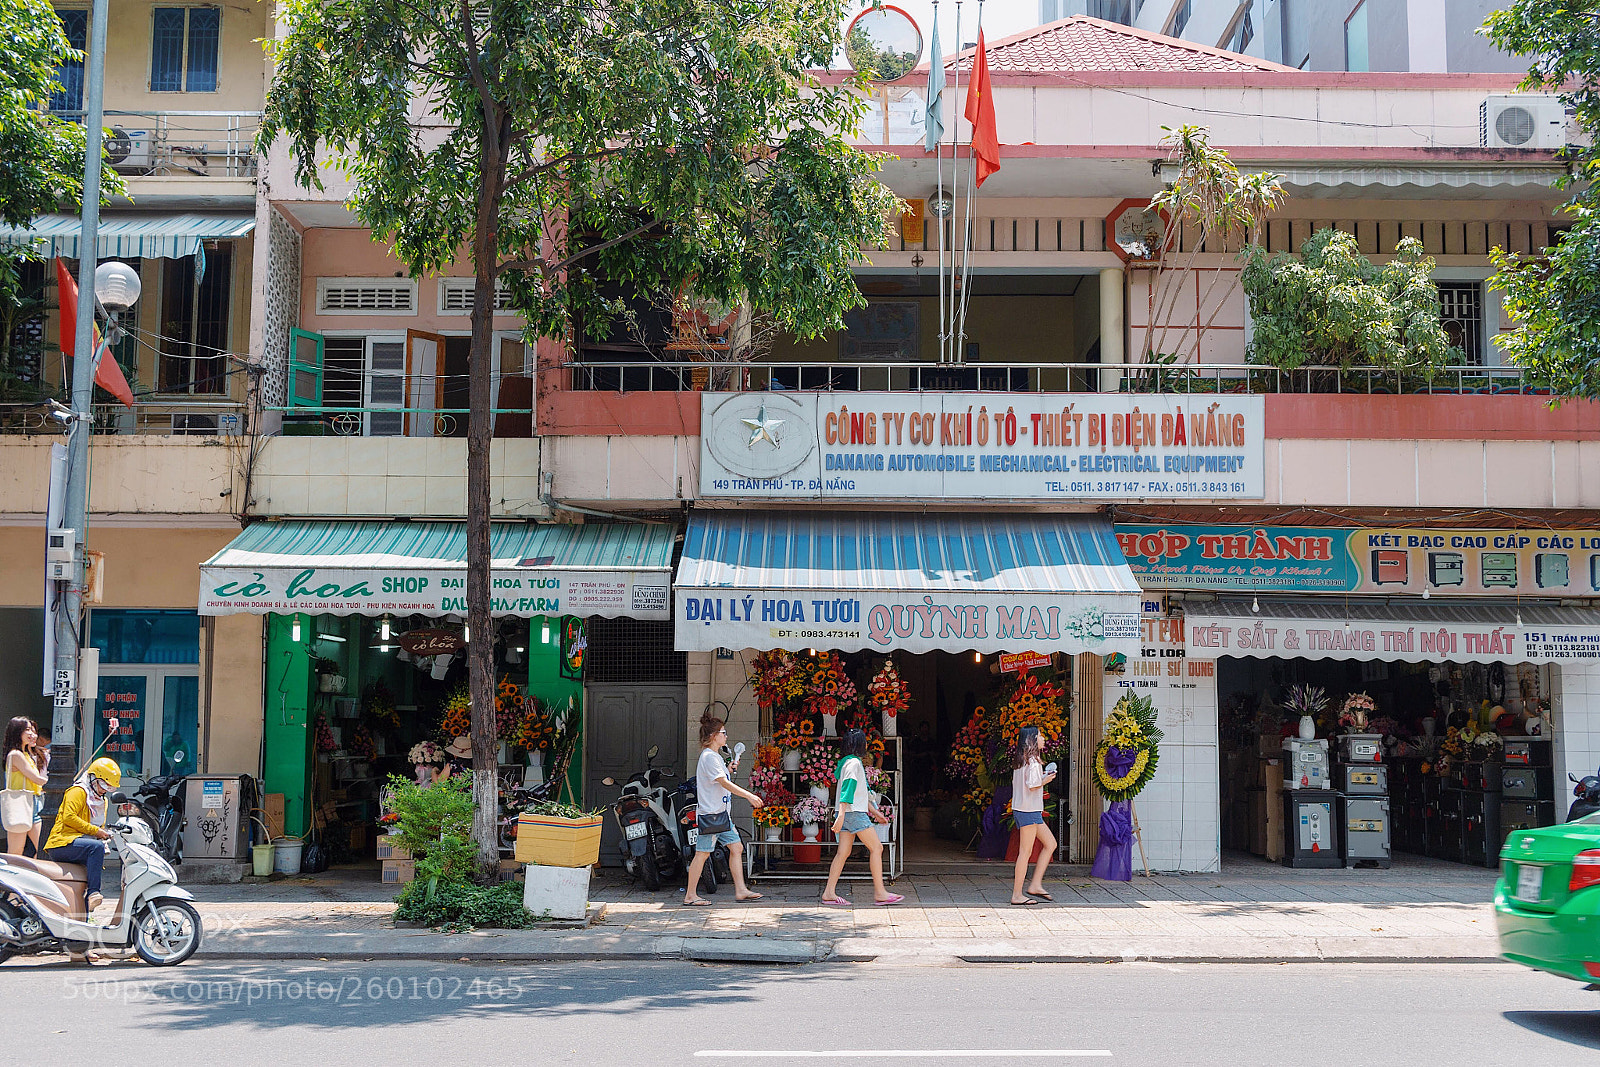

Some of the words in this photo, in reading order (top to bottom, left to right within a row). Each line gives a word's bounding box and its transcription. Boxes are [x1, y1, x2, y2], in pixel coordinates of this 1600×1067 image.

[826, 405, 877, 446] CÔNG
[882, 412, 905, 446] TY
[910, 412, 936, 446] CƠ
[941, 405, 972, 446] KHÍ
[977, 406, 989, 446] Ô
[994, 406, 1017, 446] TÔ
[1031, 403, 1083, 447] THIẾT
[1088, 413, 1107, 452] BỊ
[1112, 406, 1157, 452] ĐIỆN
[1161, 406, 1187, 447] ĐÀ
[825, 453, 884, 472] DANANG
[888, 453, 975, 472] AUTOMOBILE
[980, 454, 1070, 473] MECHANICAL
[1079, 454, 1160, 473] ELECTRICAL
[1164, 454, 1245, 475] EQUIPMENT
[712, 480, 729, 490] 149
[762, 476, 784, 490] PHÚ
[791, 480, 806, 490] TP.
[809, 477, 823, 490] ĐÀ
[1197, 528, 1334, 561] THÀNH
[1368, 532, 1402, 547] KÉT
[1450, 536, 1487, 548] CAO
[1536, 534, 1574, 549] CÁC
[1581, 537, 1600, 549] LO
[285, 569, 374, 599] hoa
[382, 576, 429, 594] SHOP
[441, 578, 464, 591] ĐẠI
[493, 578, 522, 589] HOA
[528, 577, 560, 589] TƯƠI
[441, 597, 468, 611] DAL
[686, 598, 722, 625] ĐẠI
[730, 594, 754, 622] LÝ
[762, 599, 805, 623] HOA
[812, 598, 860, 623] TƯƠI
[867, 595, 989, 646] QUỲNH
[996, 605, 1061, 640] MAI
[801, 630, 860, 638] 0983.473141
[1193, 622, 1231, 648] KÉT
[1237, 620, 1278, 649] SẮT
[1284, 629, 1300, 649] &
[1306, 630, 1375, 651] TRANG
[1381, 627, 1414, 652] TRÍ
[1420, 628, 1457, 657] NỘI
[1463, 626, 1515, 654] THẤT
[1523, 633, 1546, 642] 151
[1580, 634, 1600, 642] PHÚ
[56, 680, 70, 688] 51
